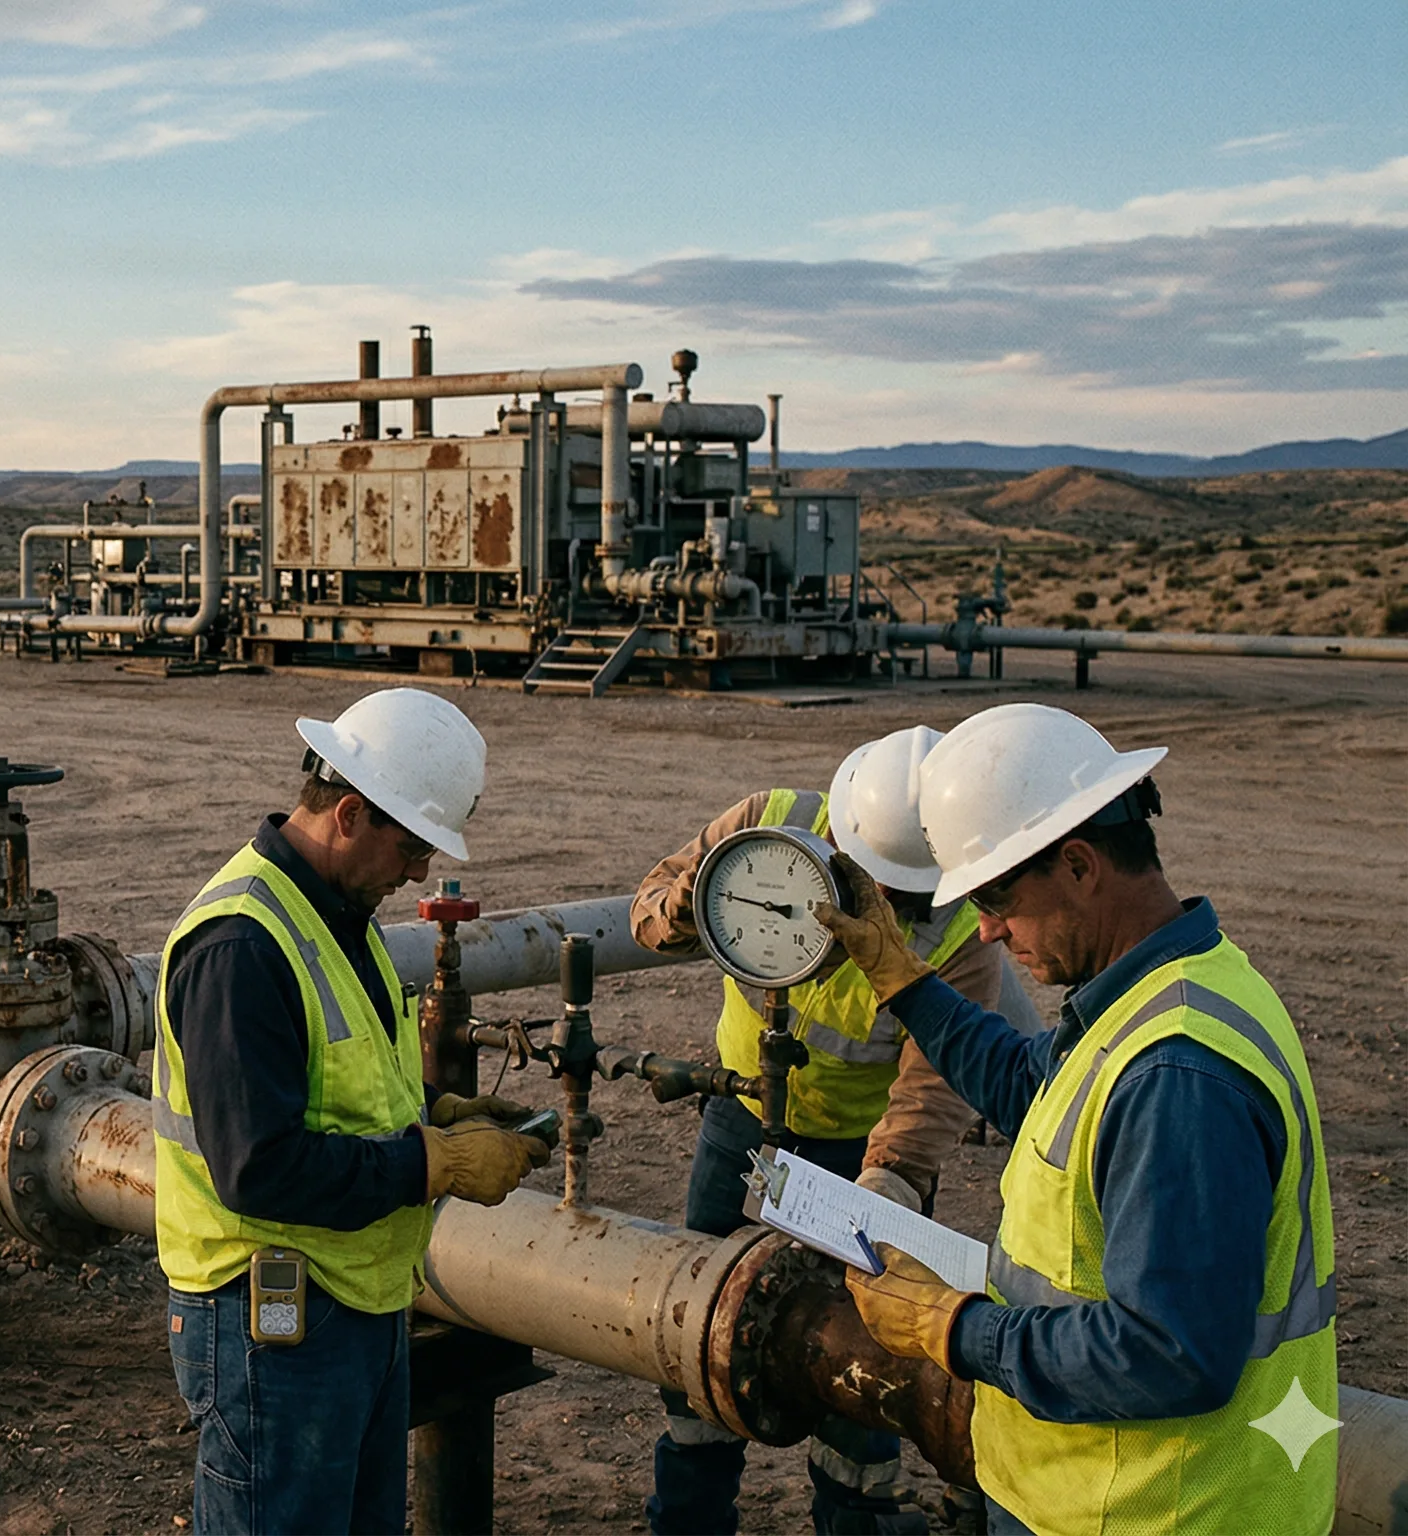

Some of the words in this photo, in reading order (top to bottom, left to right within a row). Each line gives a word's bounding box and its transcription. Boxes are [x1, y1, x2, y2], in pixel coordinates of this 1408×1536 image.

[747, 863, 753, 874] 2
[736, 927, 743, 940] 0
[793, 933, 805, 947] 10
